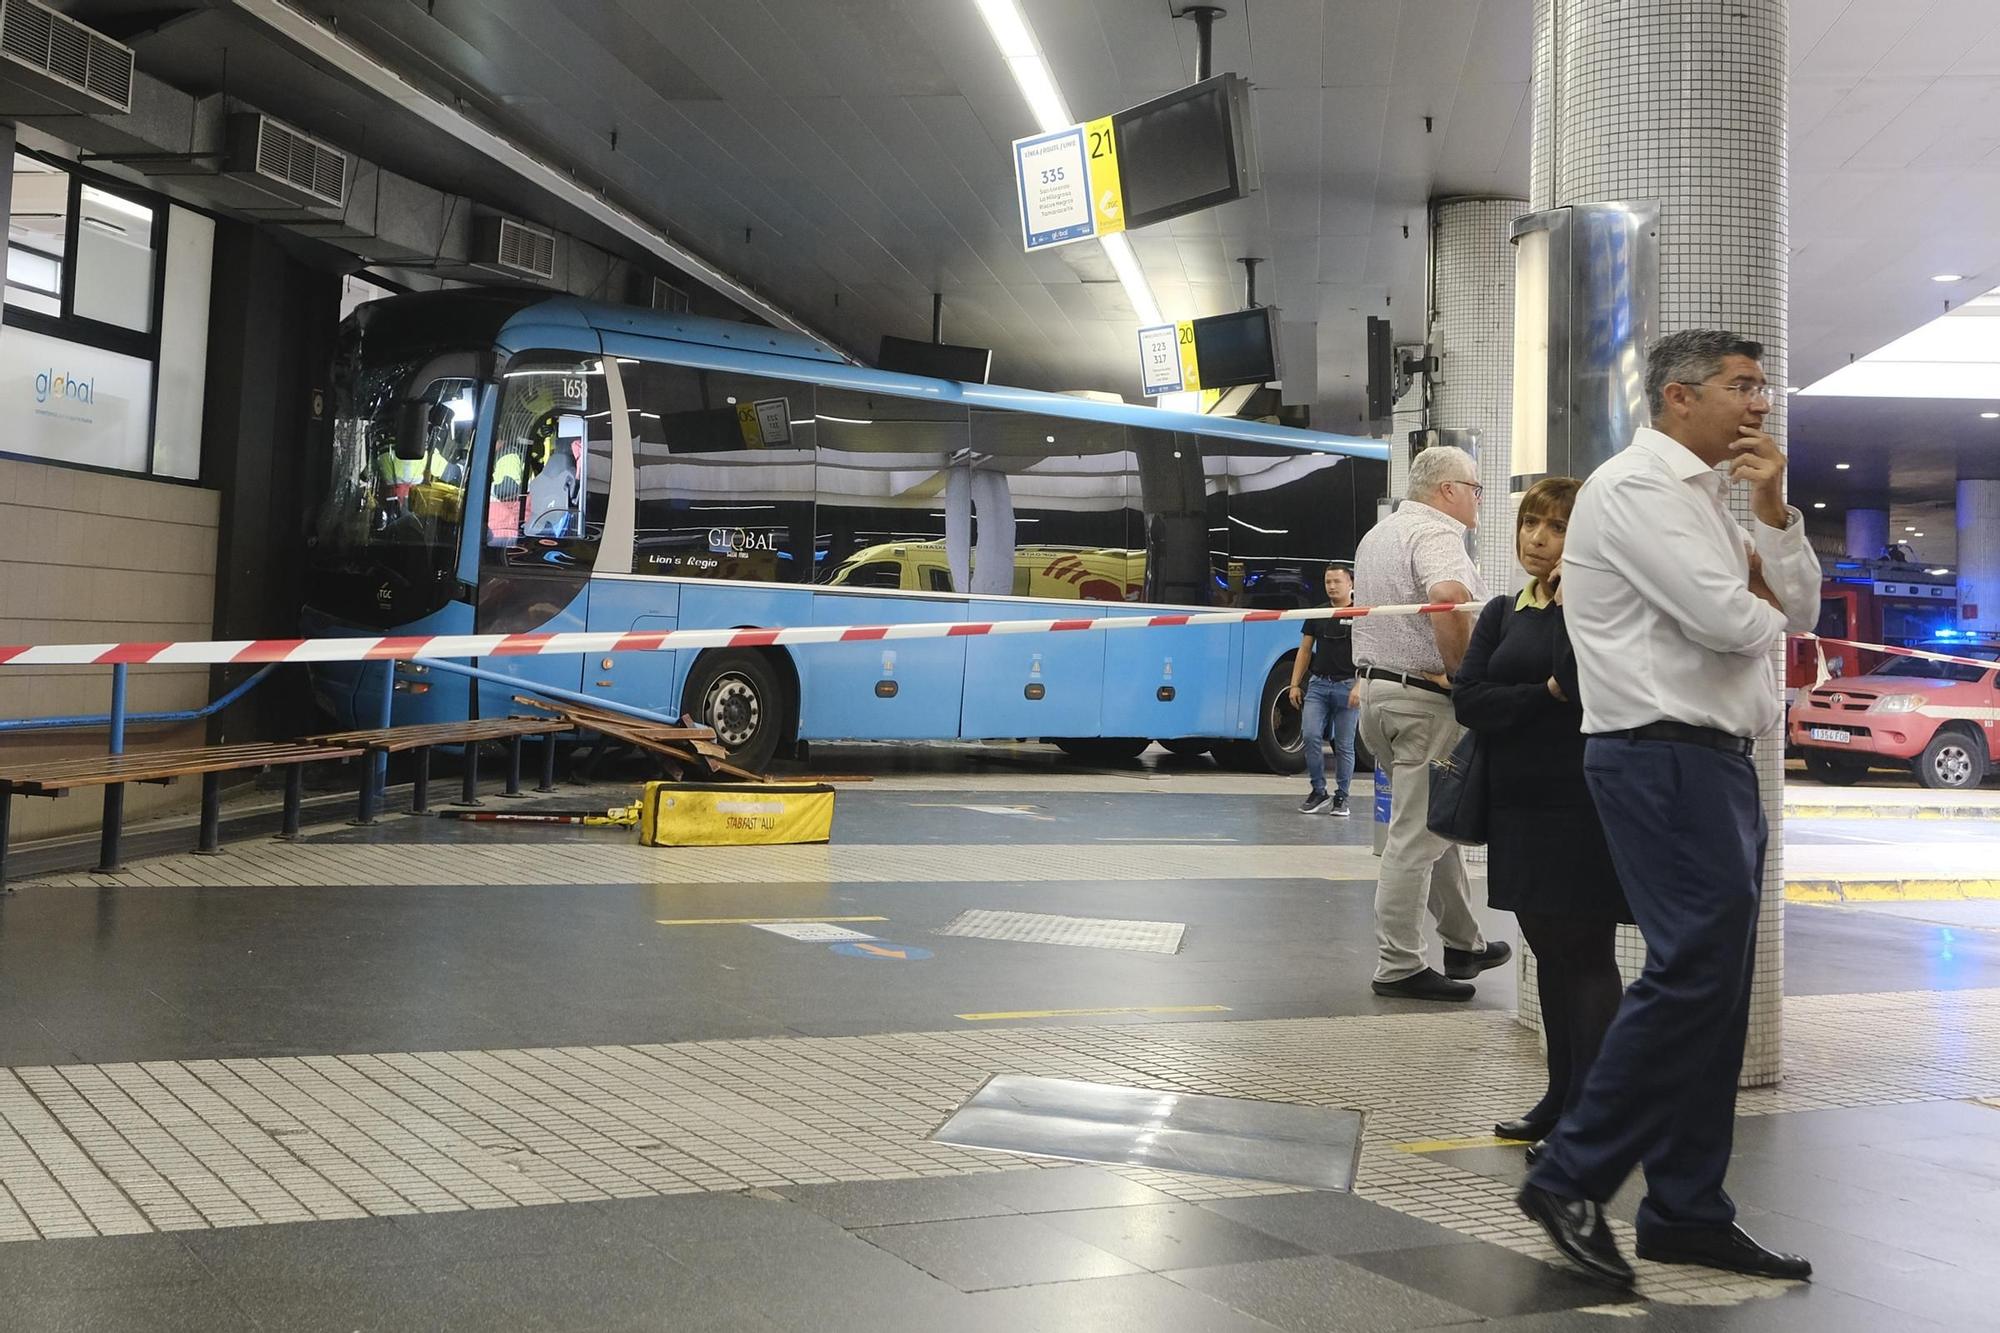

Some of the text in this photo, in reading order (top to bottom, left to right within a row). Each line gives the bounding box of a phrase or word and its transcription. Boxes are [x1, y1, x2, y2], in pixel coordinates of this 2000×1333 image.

[1090, 128, 1112, 159] 21
[1041, 167, 1065, 184] 335
[1179, 327, 1193, 345] 20
[1152, 342, 1167, 352] 223
[1153, 354, 1167, 364] 317
[35, 367, 94, 405] global
[708, 527, 778, 552] GLOBAL
[649, 555, 718, 569] Lion's Regio
